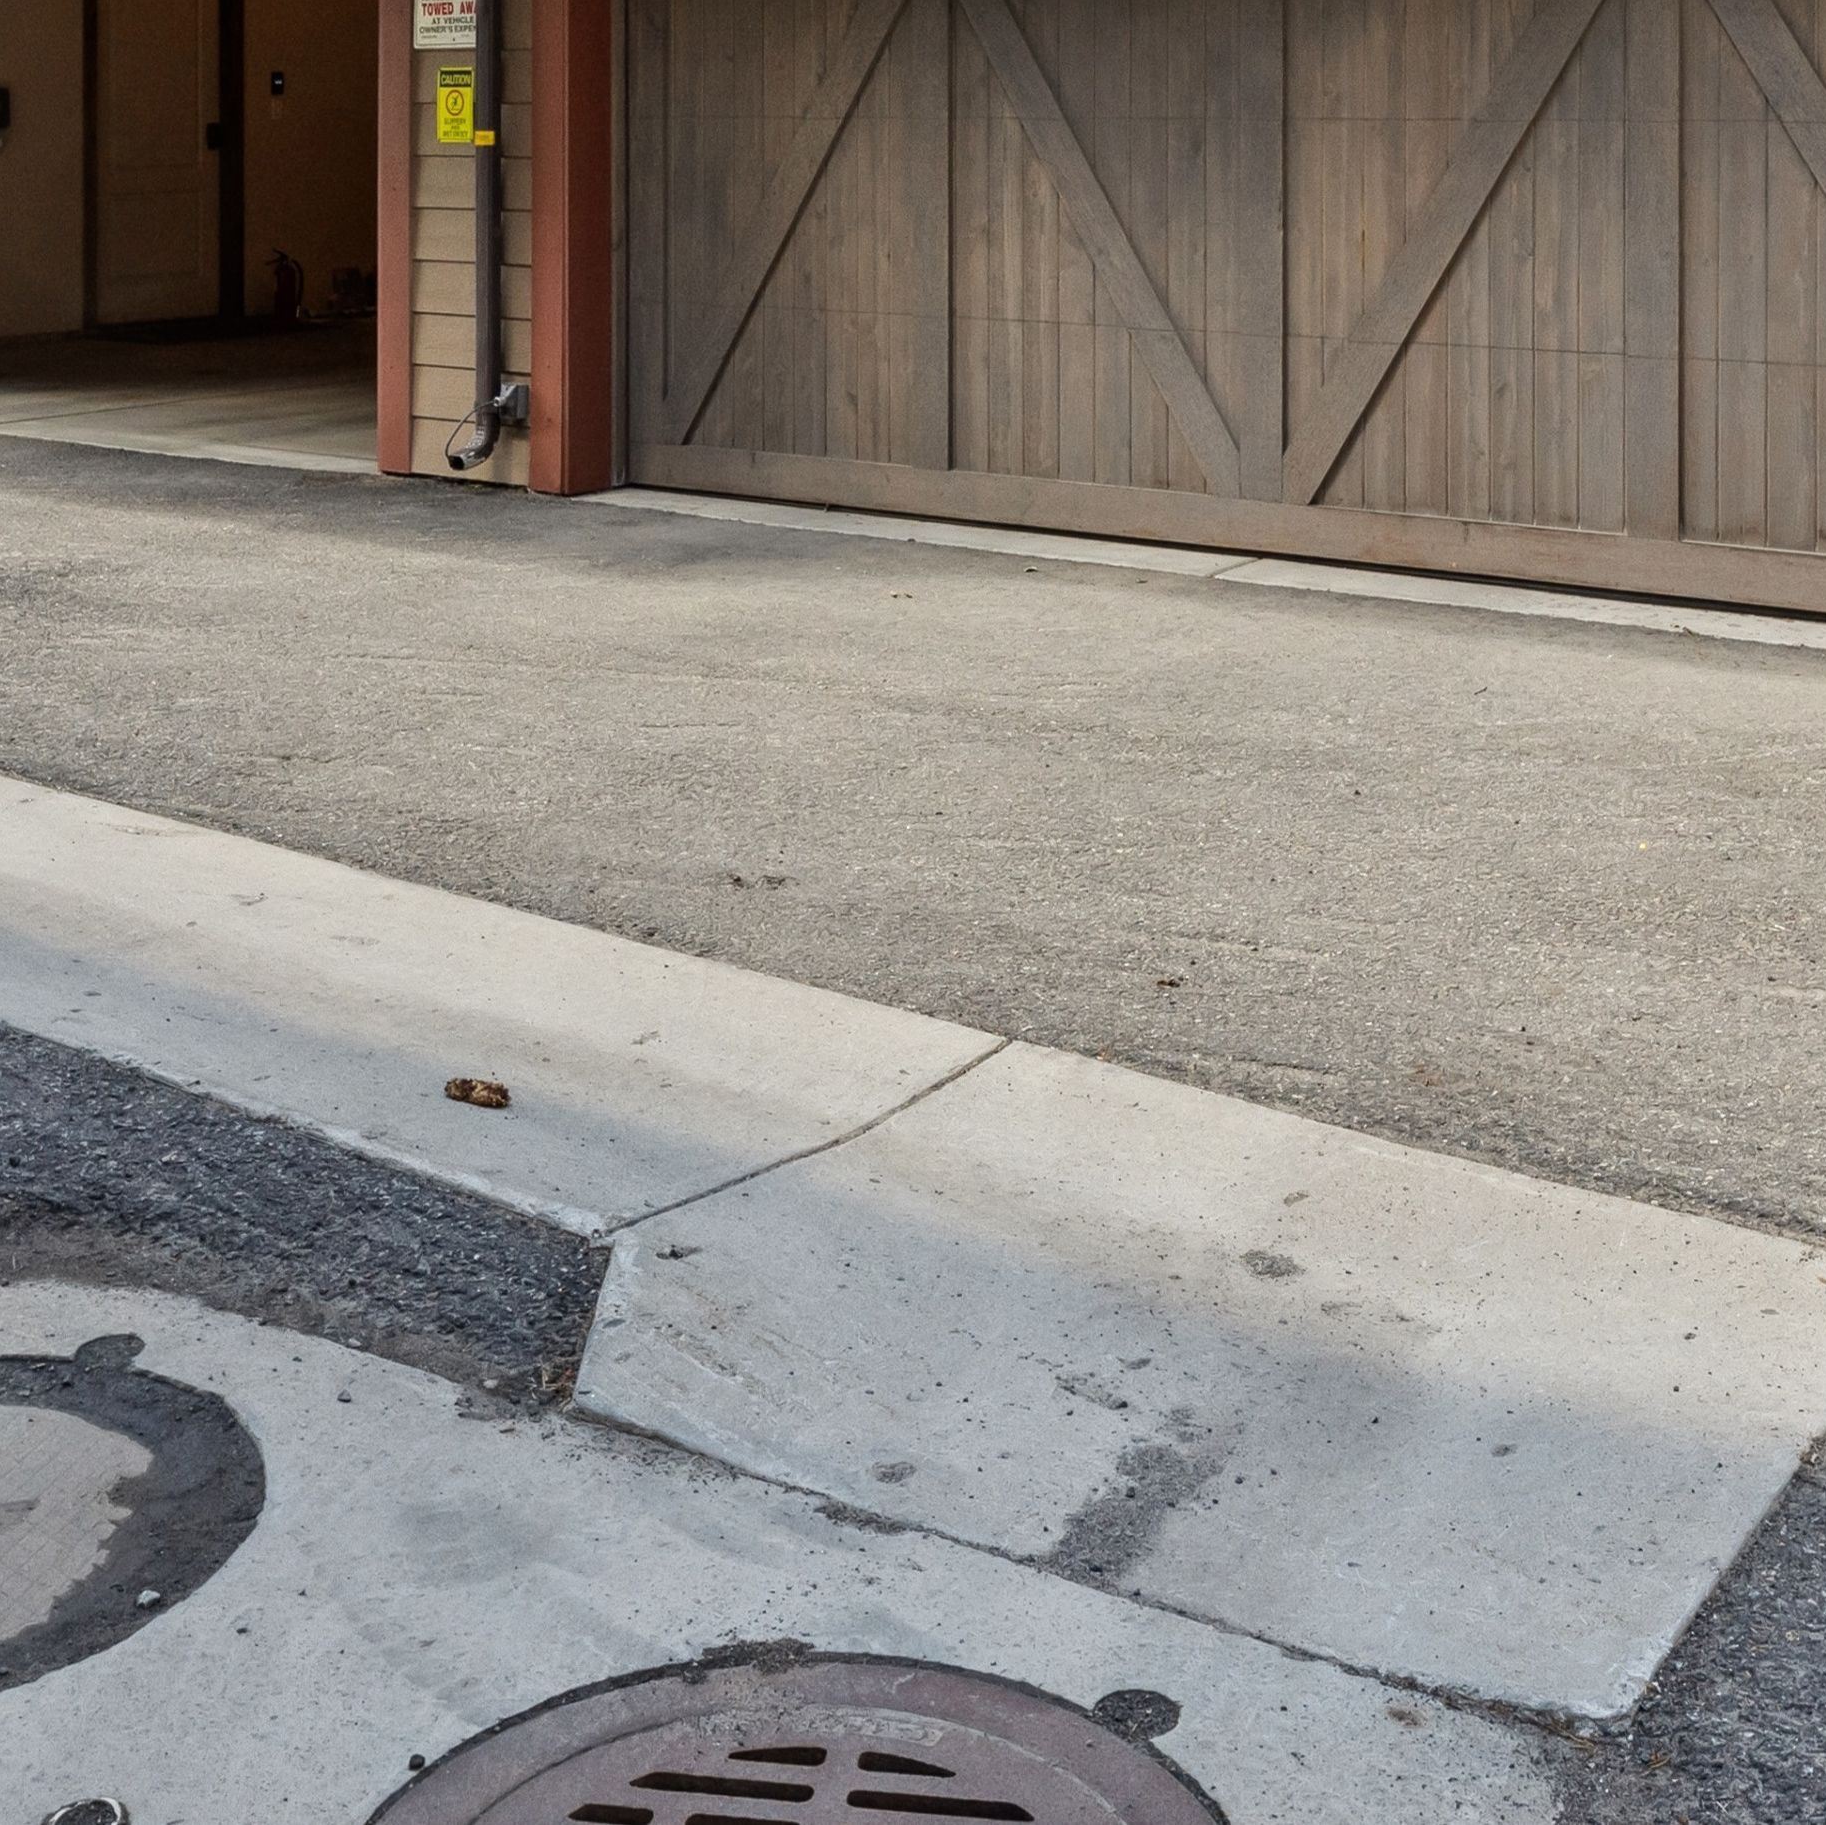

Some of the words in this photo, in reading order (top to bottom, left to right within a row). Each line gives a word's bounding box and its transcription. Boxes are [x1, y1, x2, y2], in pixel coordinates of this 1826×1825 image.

[421, 2, 454, 16] TOWED
[419, 26, 453, 34] OWNER'S
[440, 74, 471, 85] CAUTION
